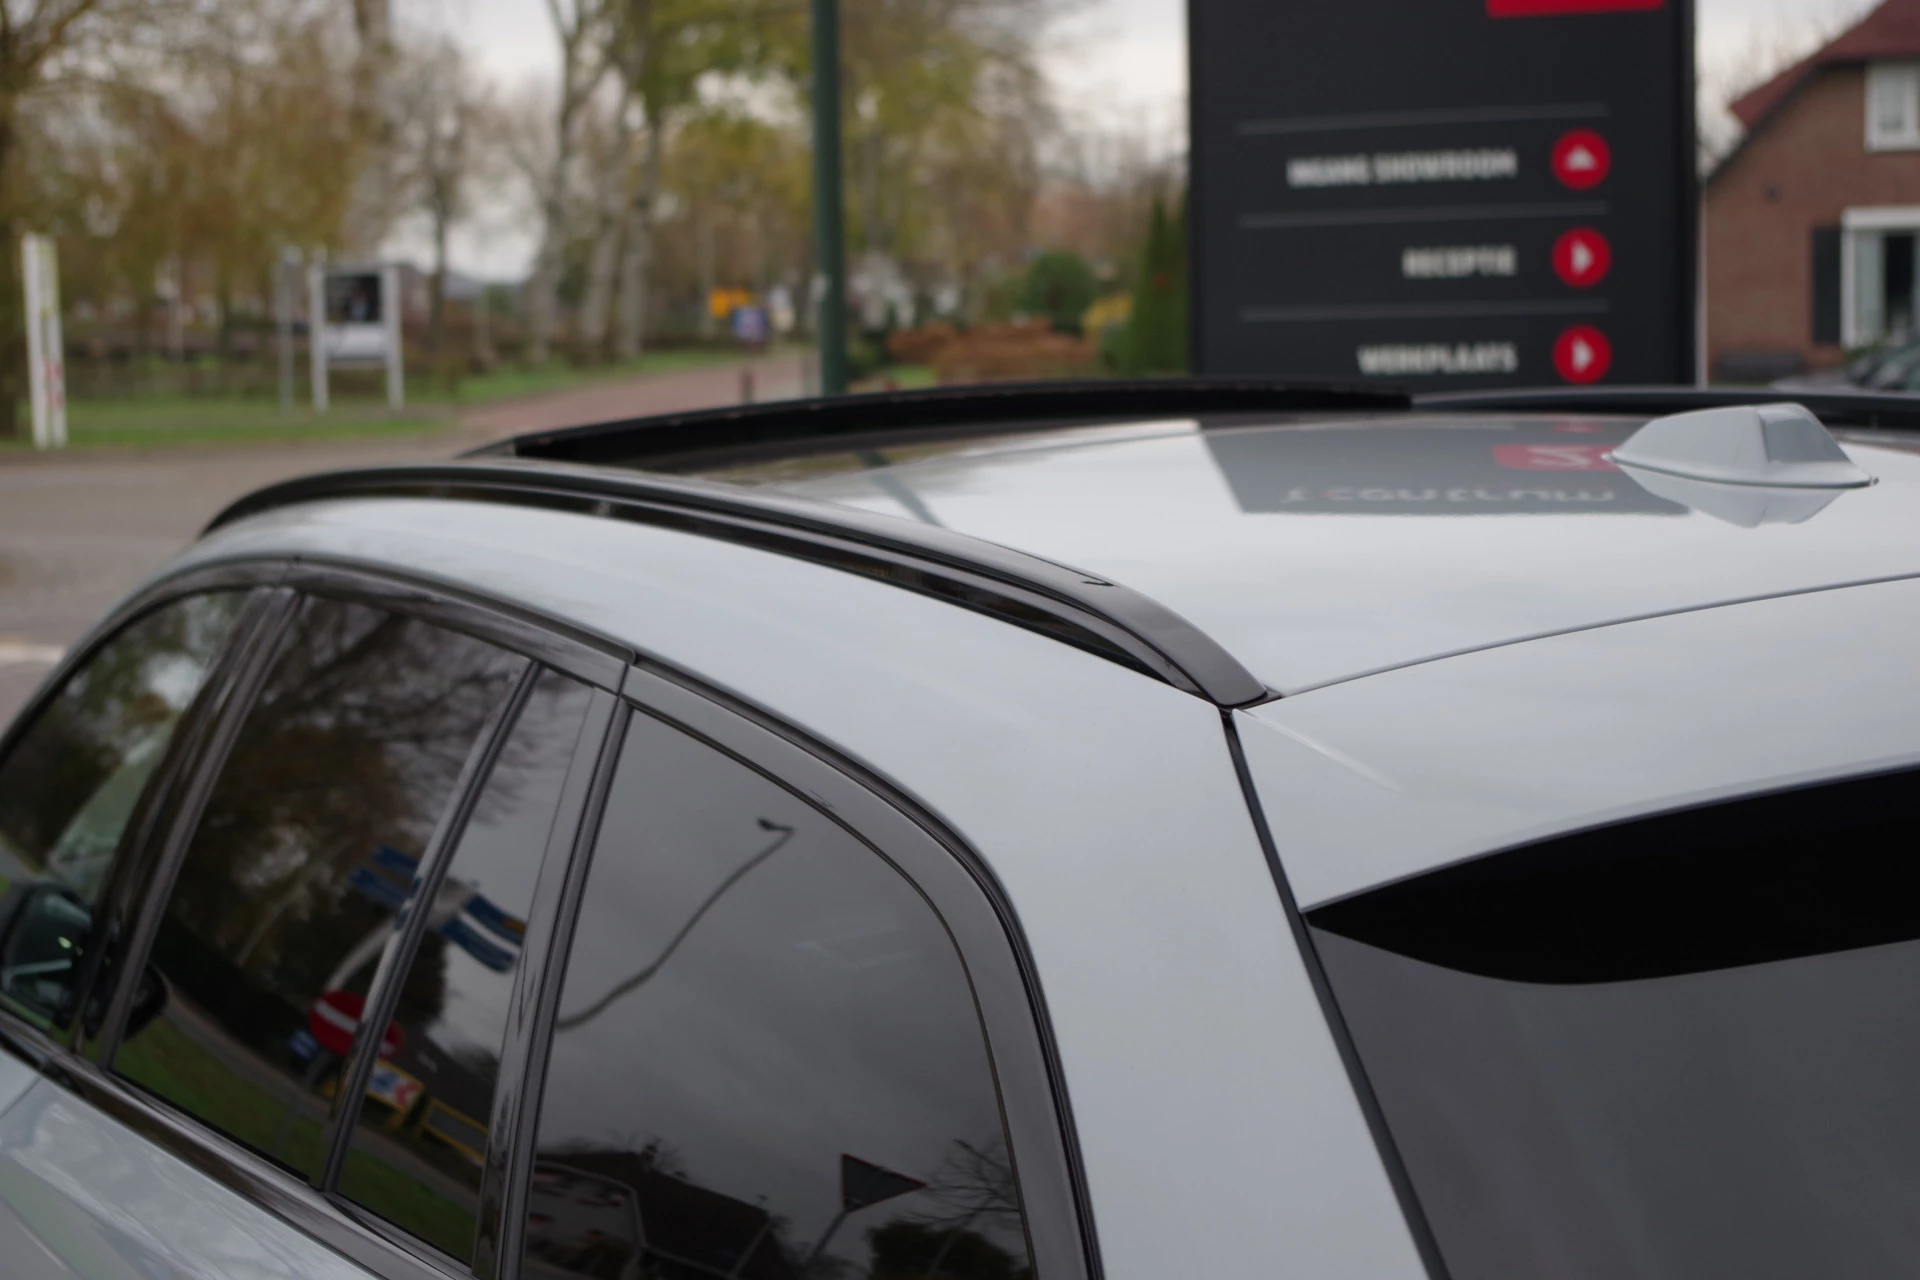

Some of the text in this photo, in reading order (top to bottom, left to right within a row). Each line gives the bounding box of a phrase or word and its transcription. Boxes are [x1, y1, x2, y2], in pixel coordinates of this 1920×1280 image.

[1372, 149, 1517, 184] SHOWROOM
[1402, 246, 1517, 277] RECEPTIE
[1357, 343, 1518, 375] WERKPLAATS
